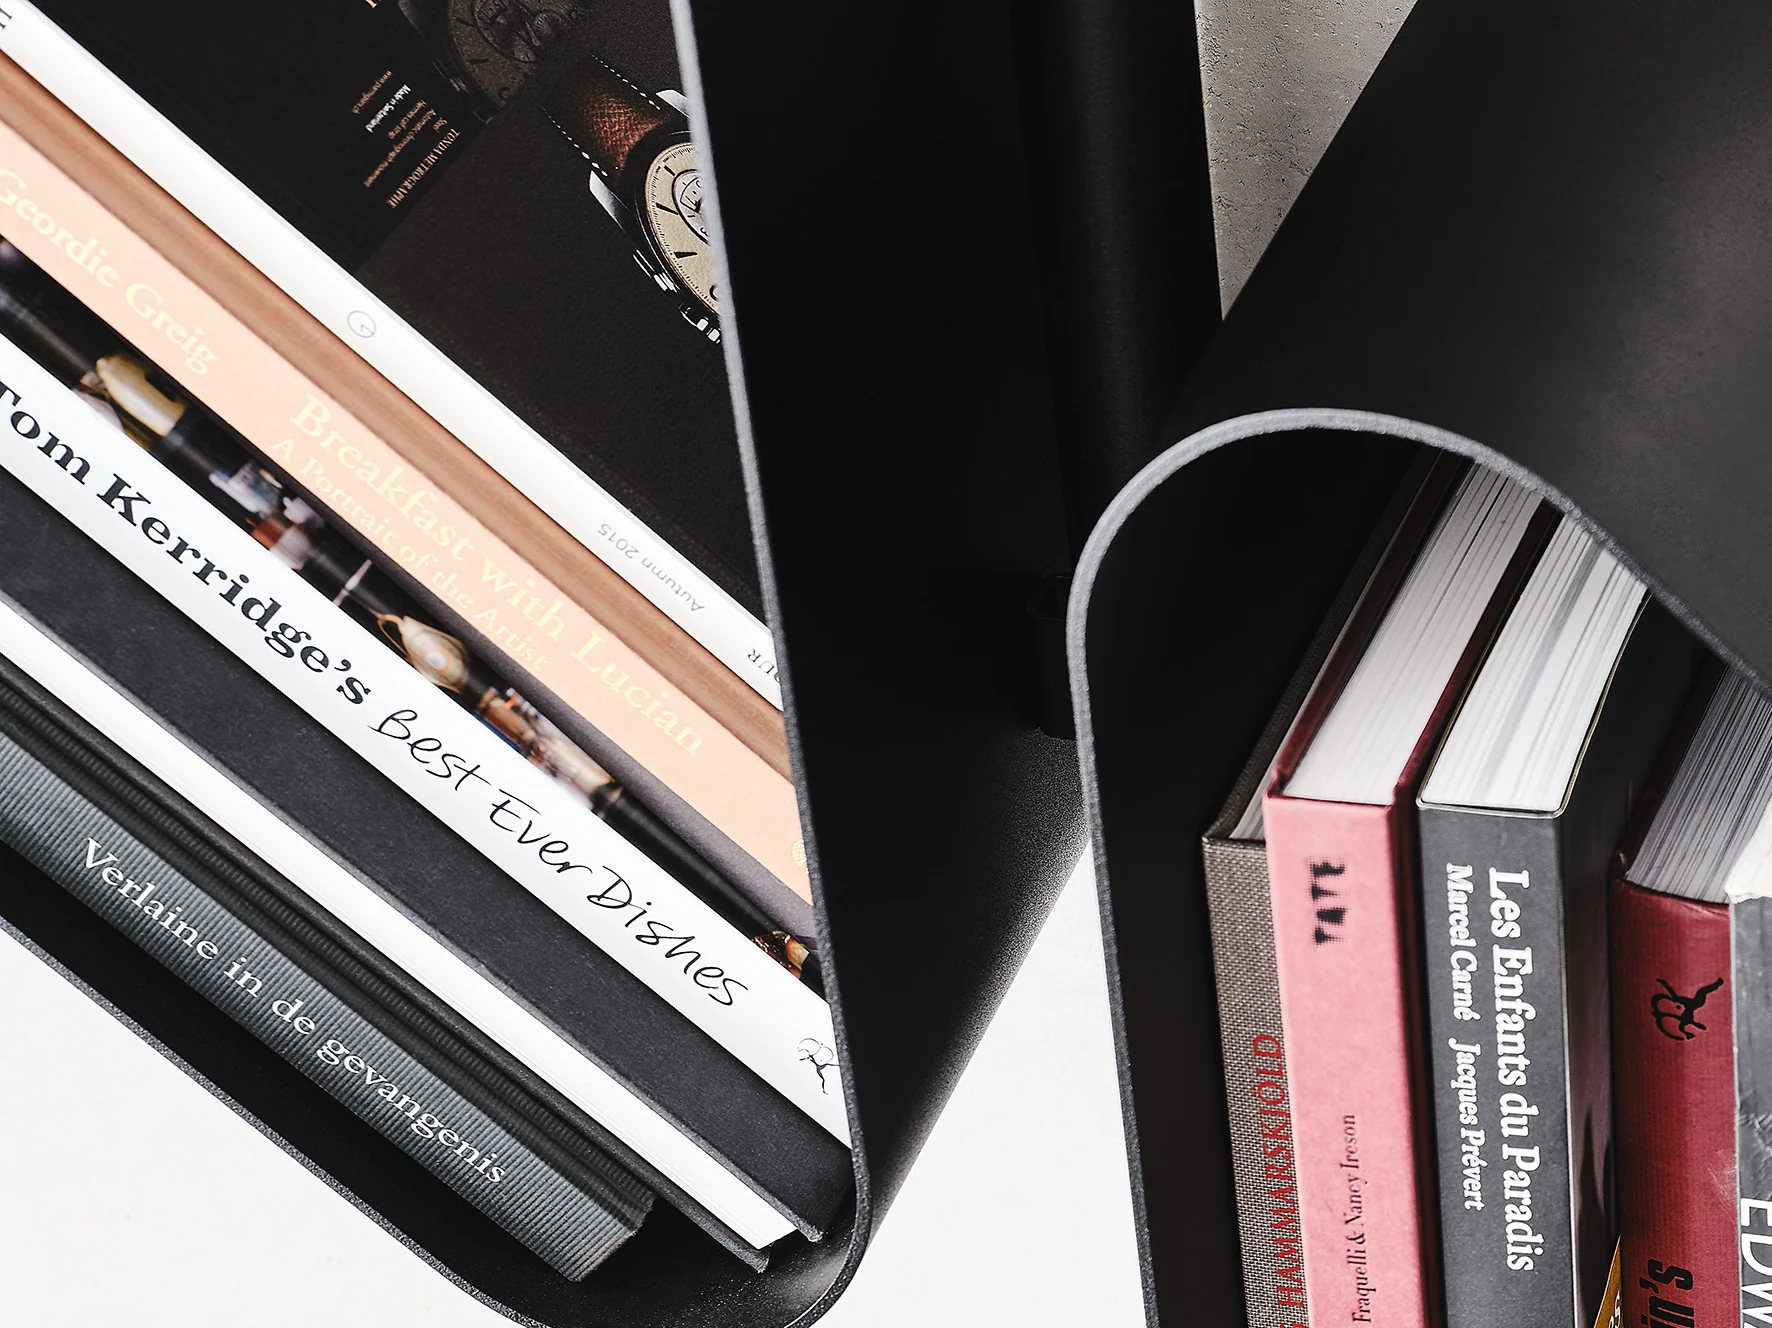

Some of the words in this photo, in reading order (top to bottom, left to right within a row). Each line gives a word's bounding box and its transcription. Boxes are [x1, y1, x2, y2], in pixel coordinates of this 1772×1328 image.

[365, 102, 394, 133] Switzerland
[394, 85, 411, 101] Made
[432, 117, 447, 131] Steel
[433, 128, 460, 154] TONDA
[386, 154, 438, 208] METROGRAPHE
[0, 168, 119, 288] Geordie
[125, 282, 220, 375] Greig
[270, 438, 296, 464] A
[299, 457, 399, 546] Portrait
[400, 544, 438, 569] of
[431, 570, 473, 609] the
[474, 607, 549, 671] Artist
[290, 395, 475, 561] Breakfast
[479, 556, 567, 643] with
[571, 638, 704, 757] Lucian
[597, 523, 641, 560] 2015
[641, 555, 705, 613] Autumn
[96, 473, 372, 705] Kerridge’s
[367, 708, 492, 792] Best
[489, 788, 593, 874] Ever
[586, 865, 749, 1007] Dishes
[1307, 857, 1347, 948] TATE
[1446, 862, 1478, 947] Marcel
[1488, 867, 1530, 939] Les
[83, 837, 220, 961] Verlaine
[223, 955, 263, 999] in
[271, 996, 317, 1037] de
[316, 1037, 508, 1184] gevangenis
[1449, 951, 1482, 1023] Carné
[1491, 943, 1537, 1088] Enfants
[1448, 1036, 1482, 1126] Jacques
[1499, 1091, 1541, 1139] du
[1253, 1034, 1305, 1308] HAMMARSKJÖLD
[1340, 1114, 1360, 1170] Ireson
[1460, 1128, 1487, 1213] Prévert
[1344, 1173, 1368, 1226] Nancy
[1501, 1145, 1546, 1274] Paradis
[1347, 1229, 1366, 1246] &
[1346, 1247, 1376, 1324] Fraquelli
